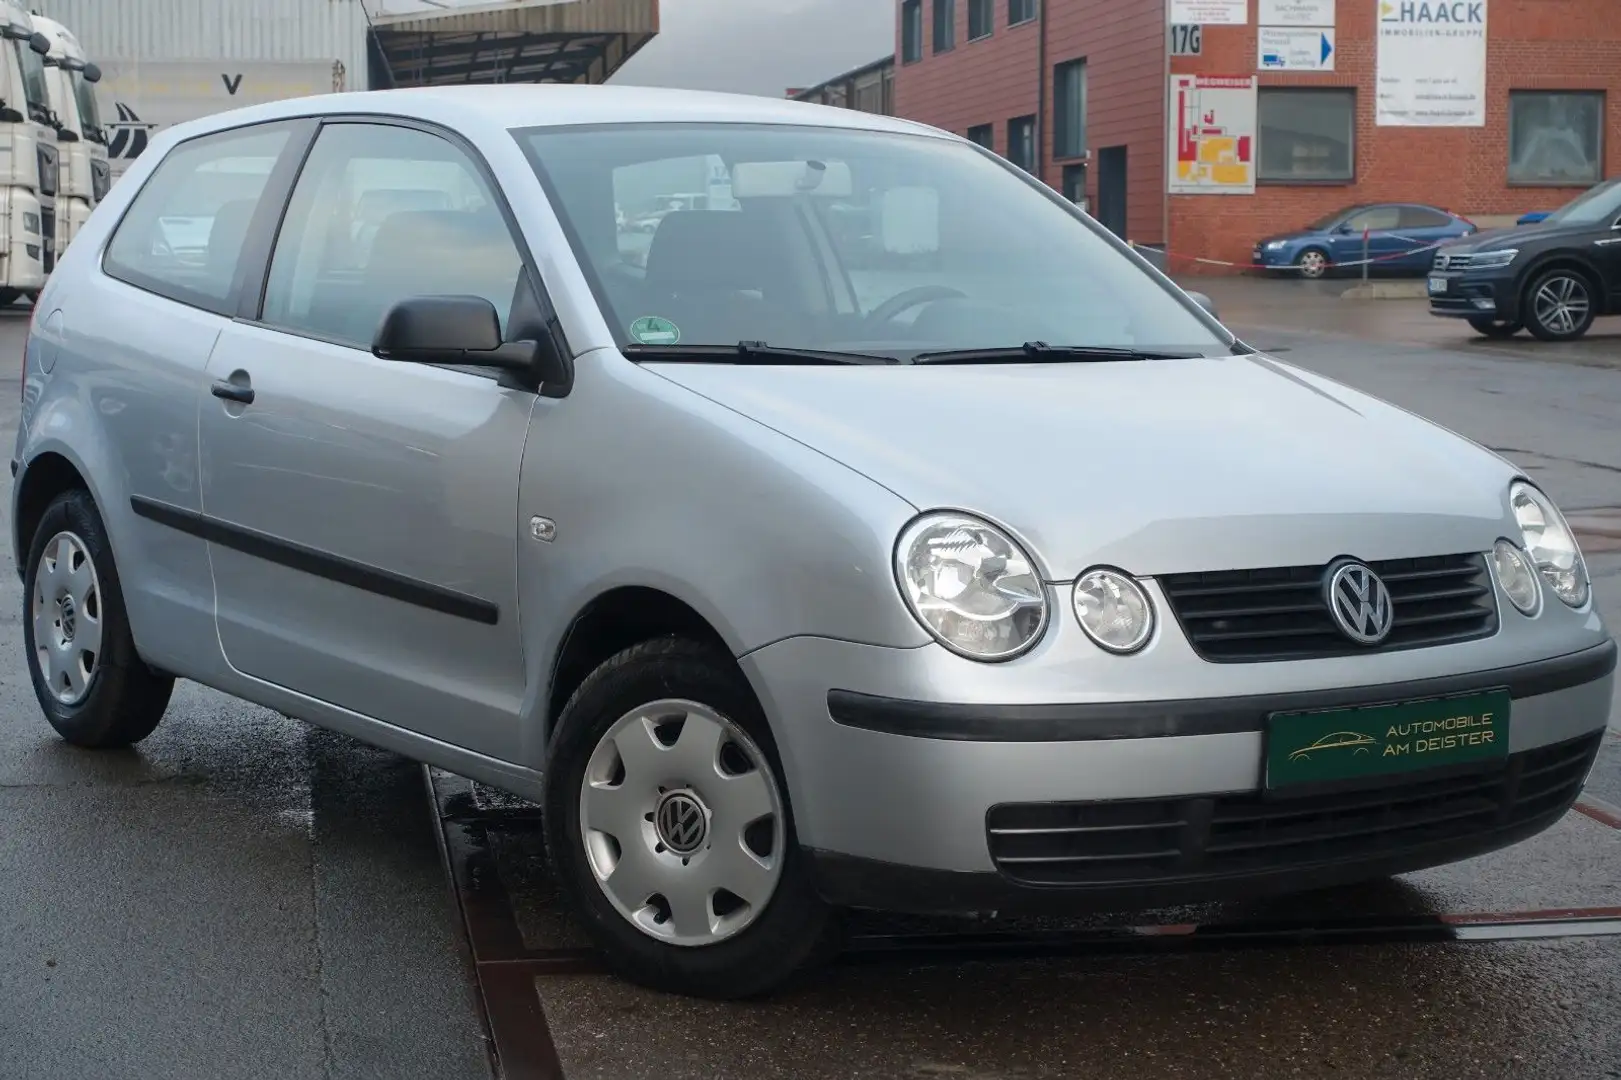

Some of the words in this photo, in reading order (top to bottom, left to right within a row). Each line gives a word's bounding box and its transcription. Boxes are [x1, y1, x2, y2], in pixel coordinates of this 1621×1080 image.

[1400, 1, 1483, 23] HAACK
[1172, 24, 1200, 53] 17G
[1380, 28, 1483, 37] IMMOBILIEN-GRUPPE
[1386, 712, 1493, 737] AUTOMOBILE
[1382, 743, 1410, 757] AM
[1416, 730, 1495, 753] DEISTER
